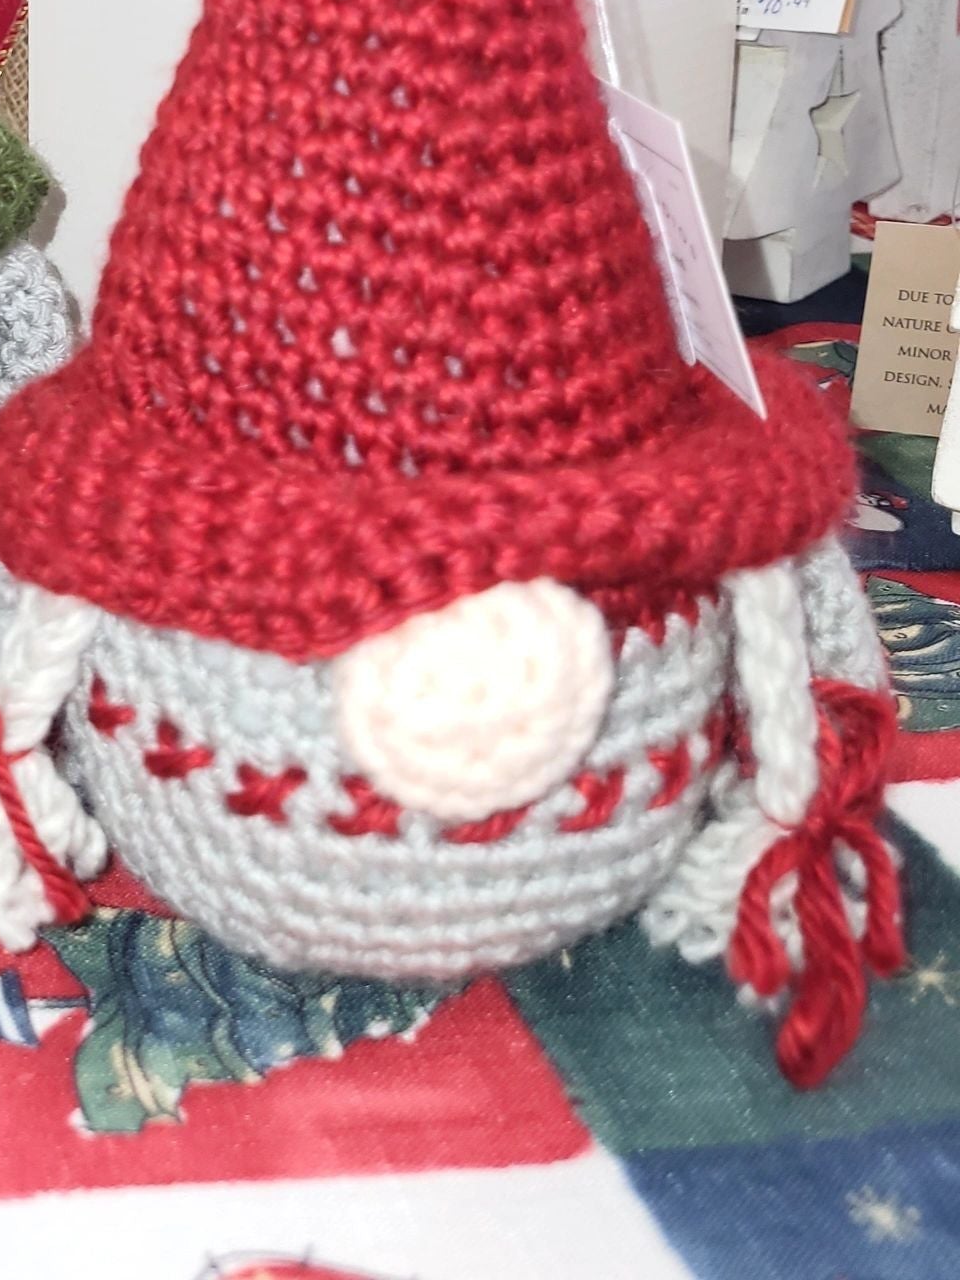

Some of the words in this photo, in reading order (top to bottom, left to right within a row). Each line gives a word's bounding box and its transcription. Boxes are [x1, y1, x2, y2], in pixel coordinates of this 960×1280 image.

[897, 289, 930, 304] DUE
[934, 293, 954, 306] TO
[882, 316, 942, 333] NATURE
[897, 345, 953, 362] MINOR
